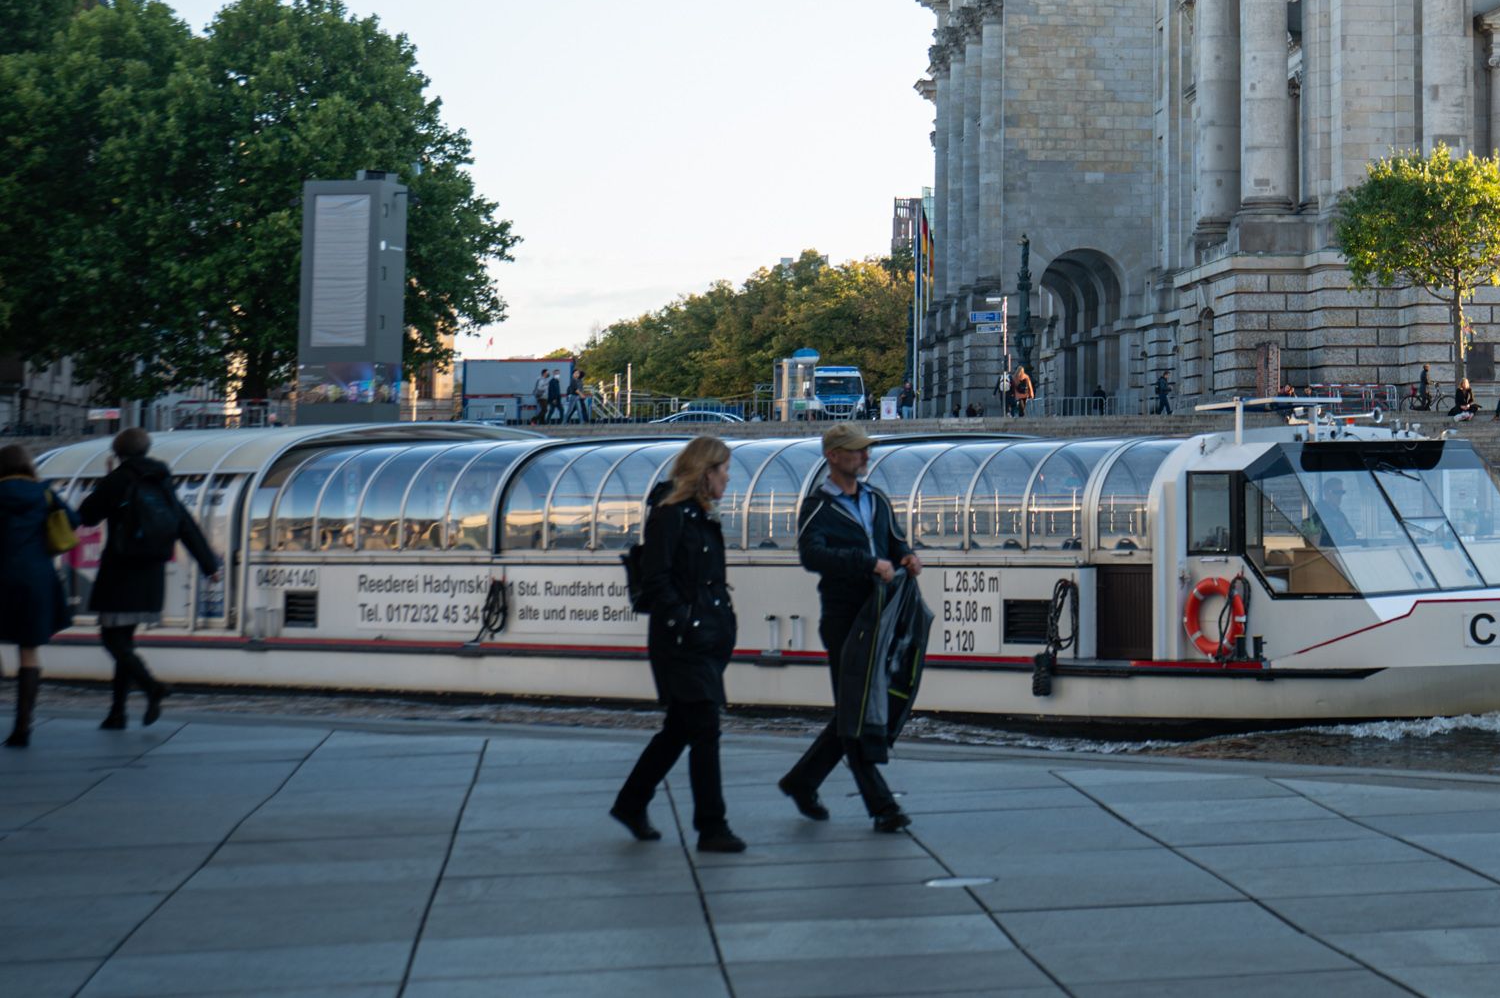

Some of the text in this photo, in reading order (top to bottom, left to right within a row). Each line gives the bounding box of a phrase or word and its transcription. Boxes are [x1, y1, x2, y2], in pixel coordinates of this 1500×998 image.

[357, 574, 489, 598] Reederei Hadynski
[517, 580, 542, 596] Std.
[544, 581, 605, 597] Rundfahrt
[955, 570, 986, 597] 26,36
[358, 604, 383, 622] Tel.
[386, 603, 439, 623] 0172/32
[442, 604, 459, 623] 45
[518, 605, 638, 622] alte und neue Berlin
[981, 605, 992, 623] m
[955, 629, 975, 652] 120
